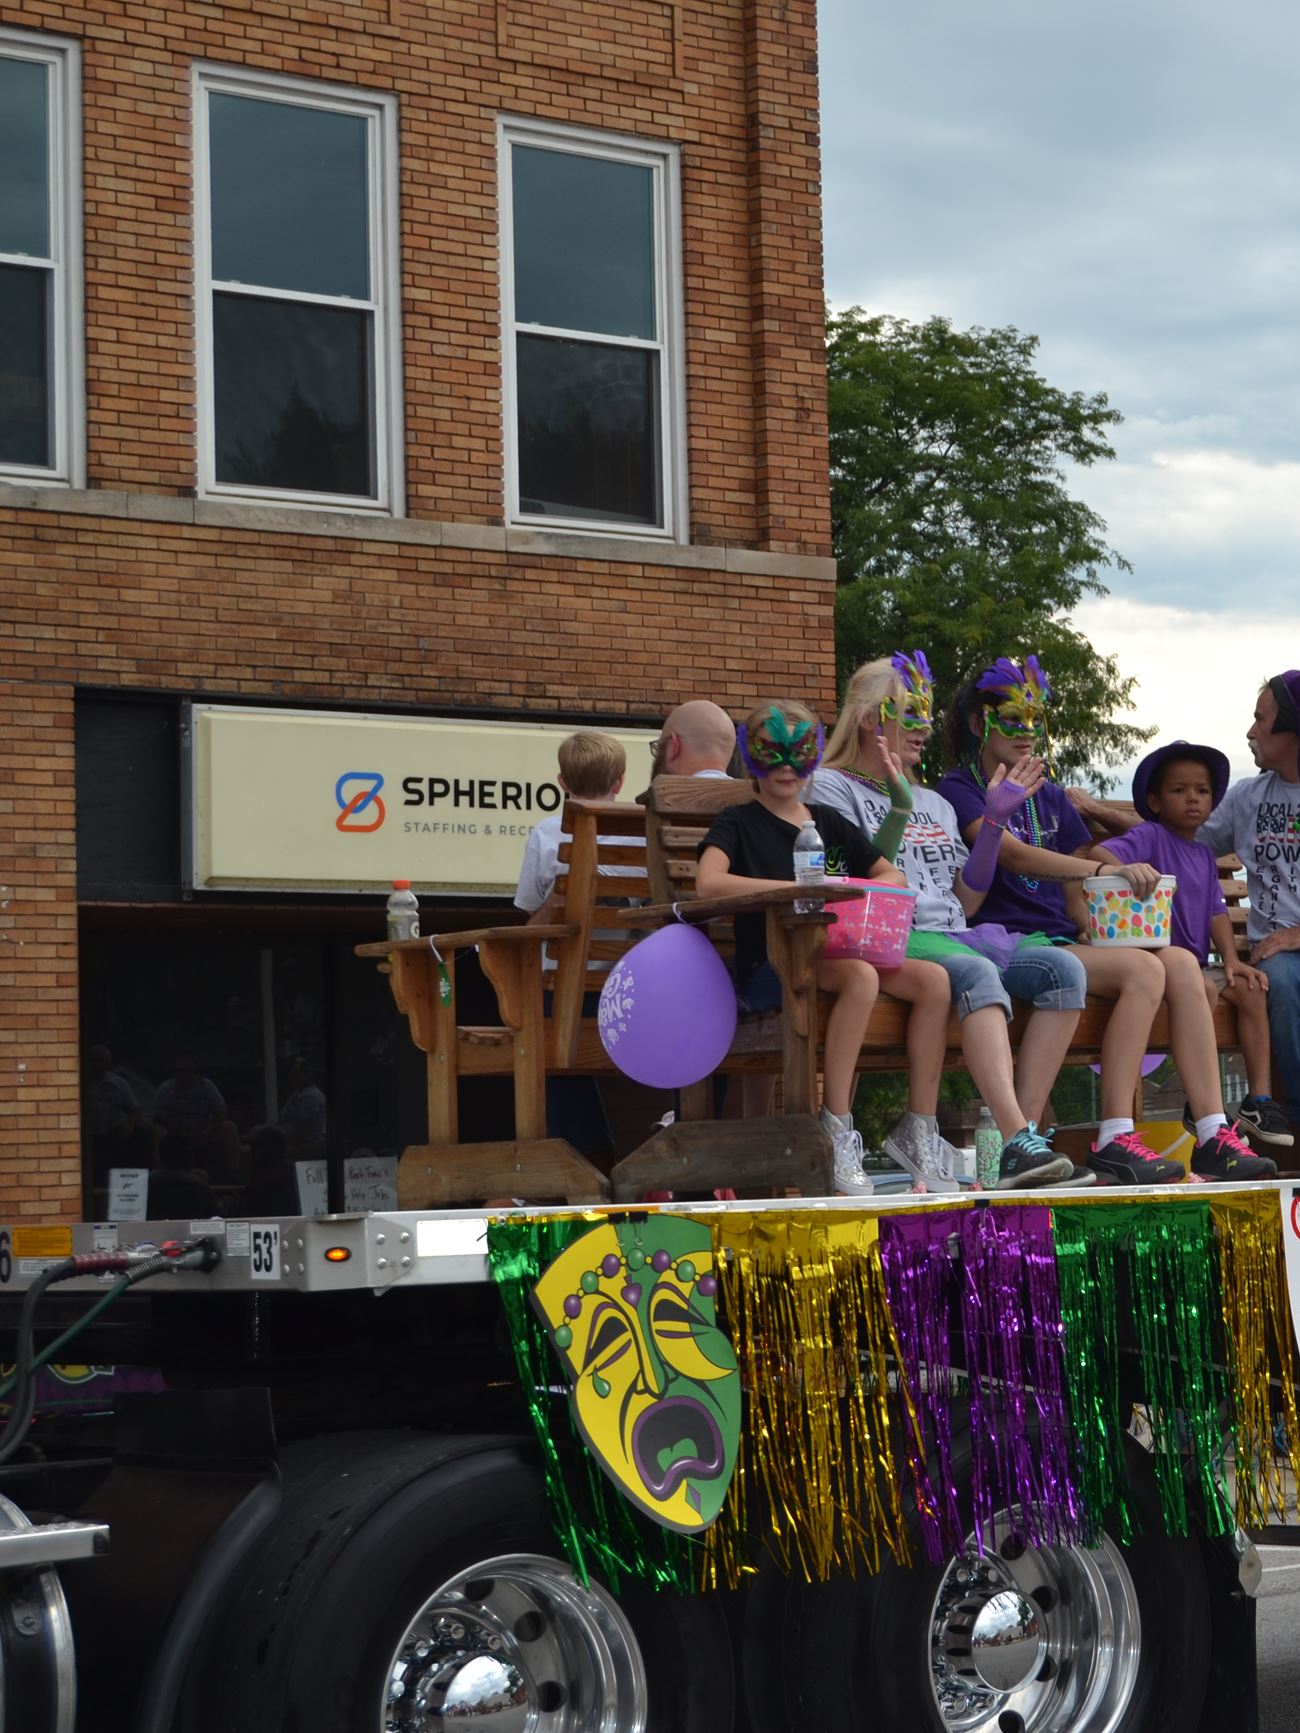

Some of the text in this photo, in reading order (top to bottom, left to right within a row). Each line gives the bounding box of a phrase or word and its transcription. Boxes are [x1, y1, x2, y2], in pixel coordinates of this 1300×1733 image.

[402, 776, 570, 812] SPHERIO
[1258, 802, 1293, 817] LOCAL
[404, 822, 477, 834] STAFFING
[483, 825, 493, 835] &
